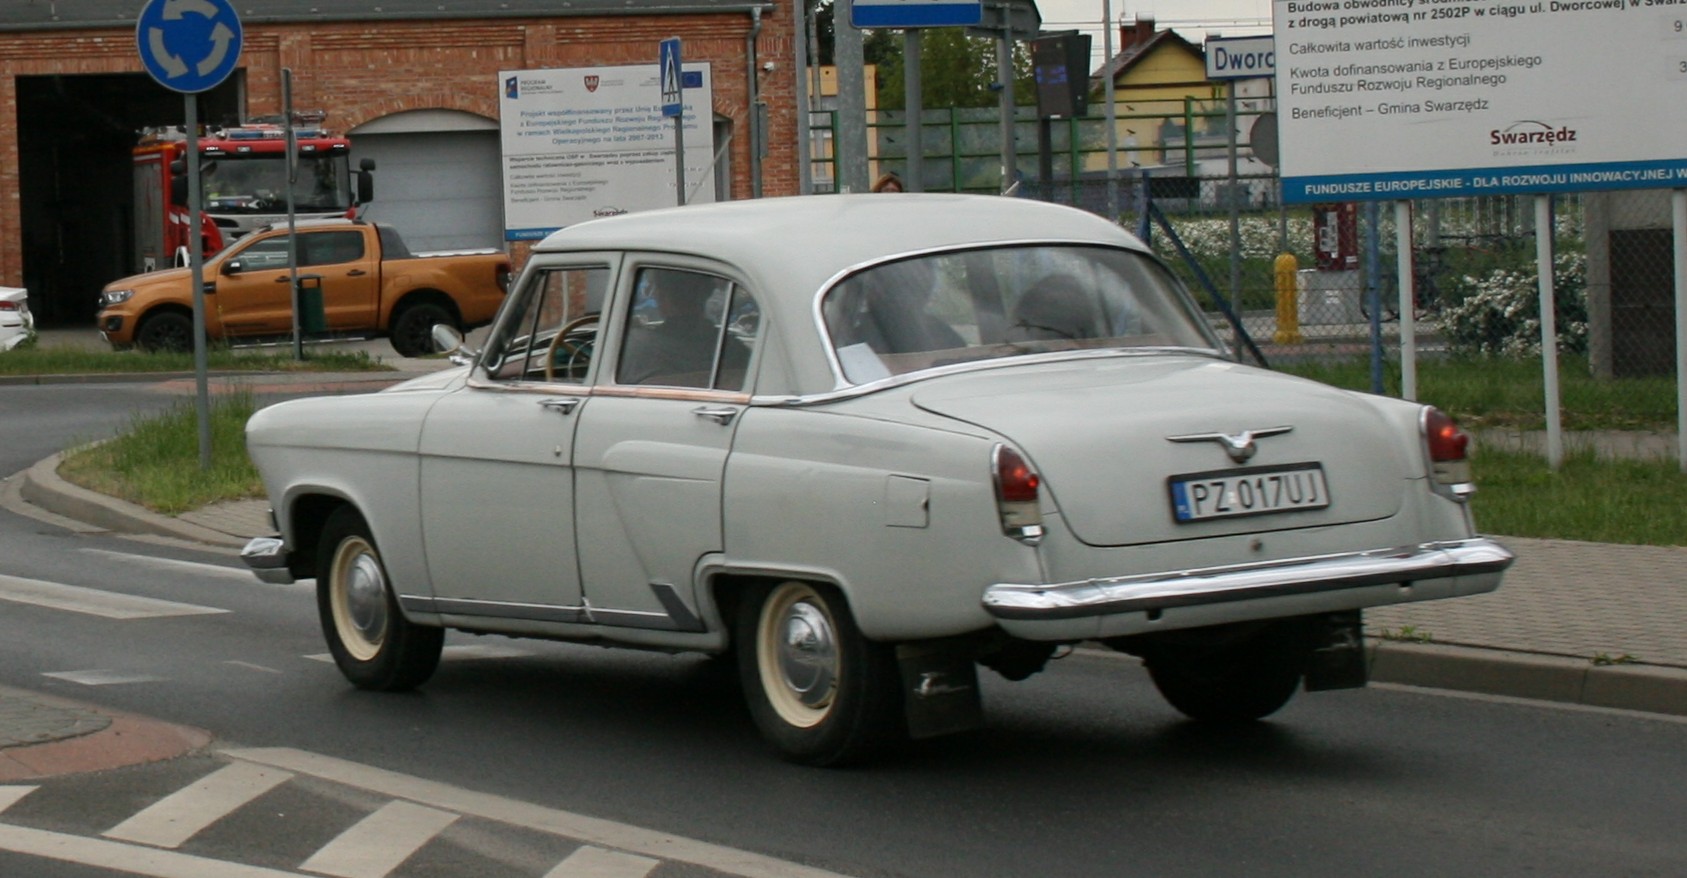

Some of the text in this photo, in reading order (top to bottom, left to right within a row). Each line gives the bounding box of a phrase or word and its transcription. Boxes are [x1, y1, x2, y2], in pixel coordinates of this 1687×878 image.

[1287, 0, 1340, 13] Budowa
[1288, 19, 1295, 28] z
[1299, 16, 1336, 29] drogą
[1340, 11, 1410, 28] powiatową
[1413, 11, 1427, 20] nr
[1430, 7, 1471, 19] 2502P
[1474, 8, 1485, 16] w
[1489, 5, 1526, 17] ciągu
[1529, 2, 1546, 13] ul.
[1550, 0, 1625, 12] Dworcowej
[1674, 20, 1683, 32] 9
[1289, 33, 1471, 55] Całkowita wartość inwestycji
[1215, 46, 1275, 71] Dworc
[1290, 55, 1542, 79] Kwota dofinansowania z Europejskiego
[1291, 74, 1507, 95] Funduszu Rozwoju Regionalnego
[1291, 105, 1362, 119] Beneficjent
[1378, 101, 1420, 115] Gmina
[1424, 98, 1489, 113] Swarzędz
[1490, 126, 1577, 146] Swarzędz
[1305, 181, 1371, 195] FUNDUSZE
[1374, 177, 1463, 192] EUROPEJSKIE
[1473, 176, 1499, 188] DLA
[1502, 173, 1566, 186] ROZWOJU
[1569, 169, 1674, 184] INNOWACYJNEJ
[1192, 473, 1318, 515] PZ 017UJ
